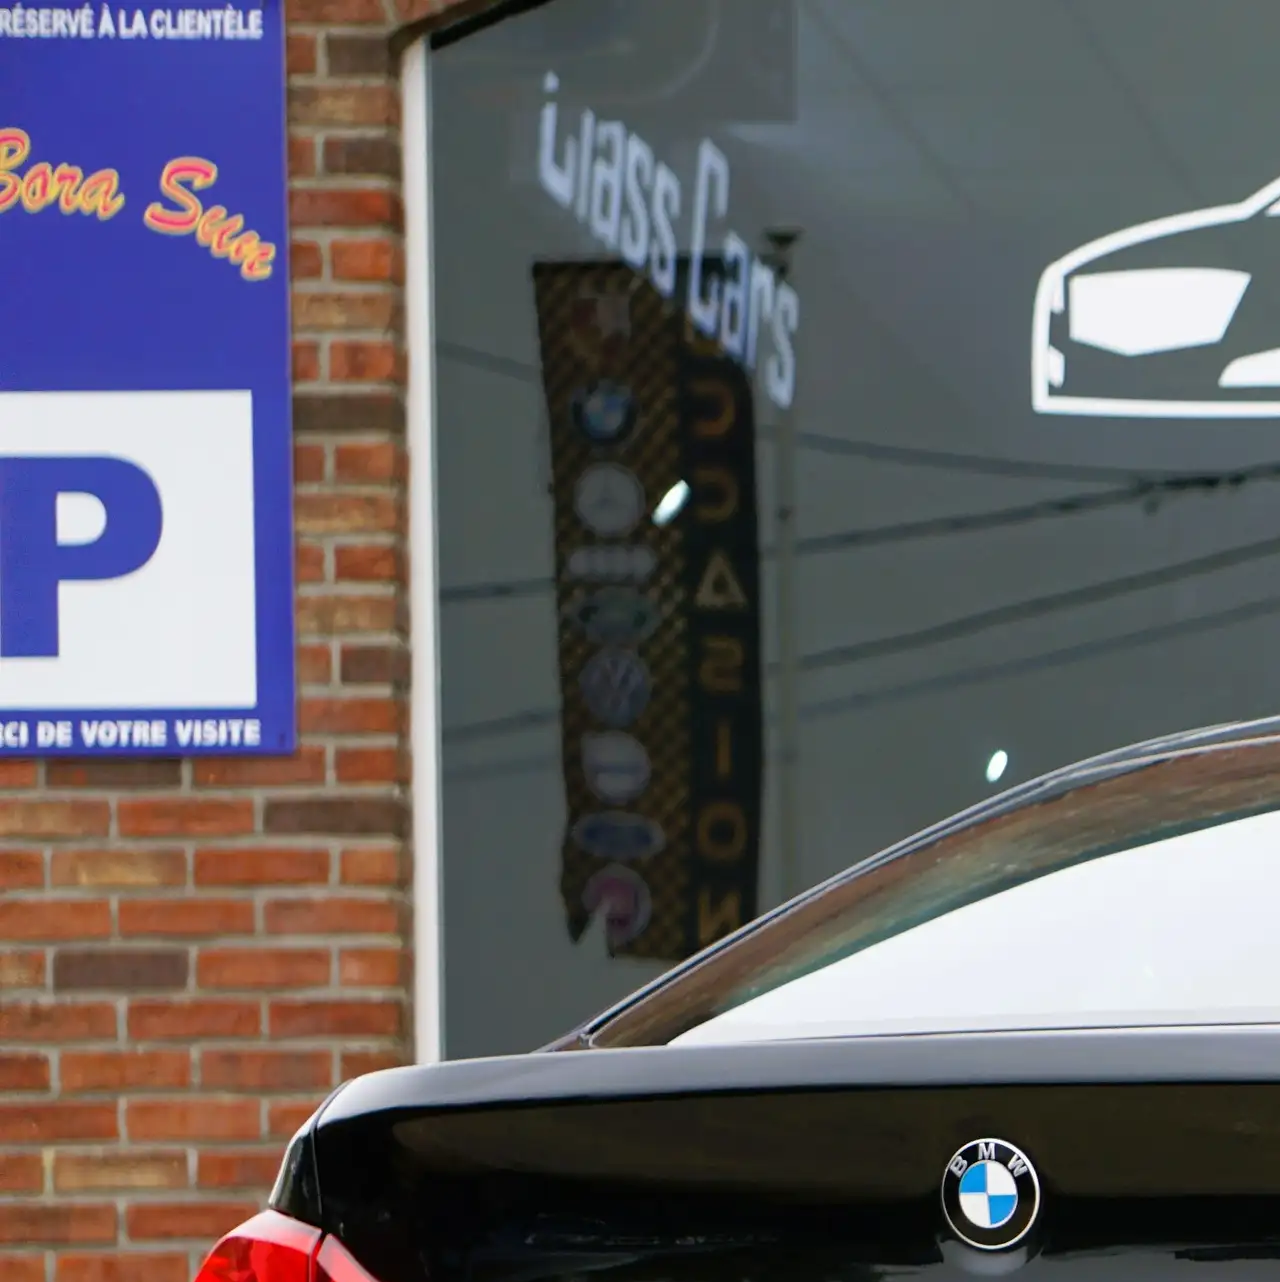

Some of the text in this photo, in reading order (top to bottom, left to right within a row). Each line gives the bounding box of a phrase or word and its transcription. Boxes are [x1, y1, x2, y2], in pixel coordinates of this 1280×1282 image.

[98, 3, 116, 39] À
[119, 8, 148, 39] LA
[150, 4, 264, 39] CLIENTÈLE
[0, 456, 163, 658] P
[36, 720, 73, 747] DE
[80, 719, 167, 747] VOTRE
[174, 718, 261, 746] VISITE
[949, 1142, 1028, 1178] BMW
